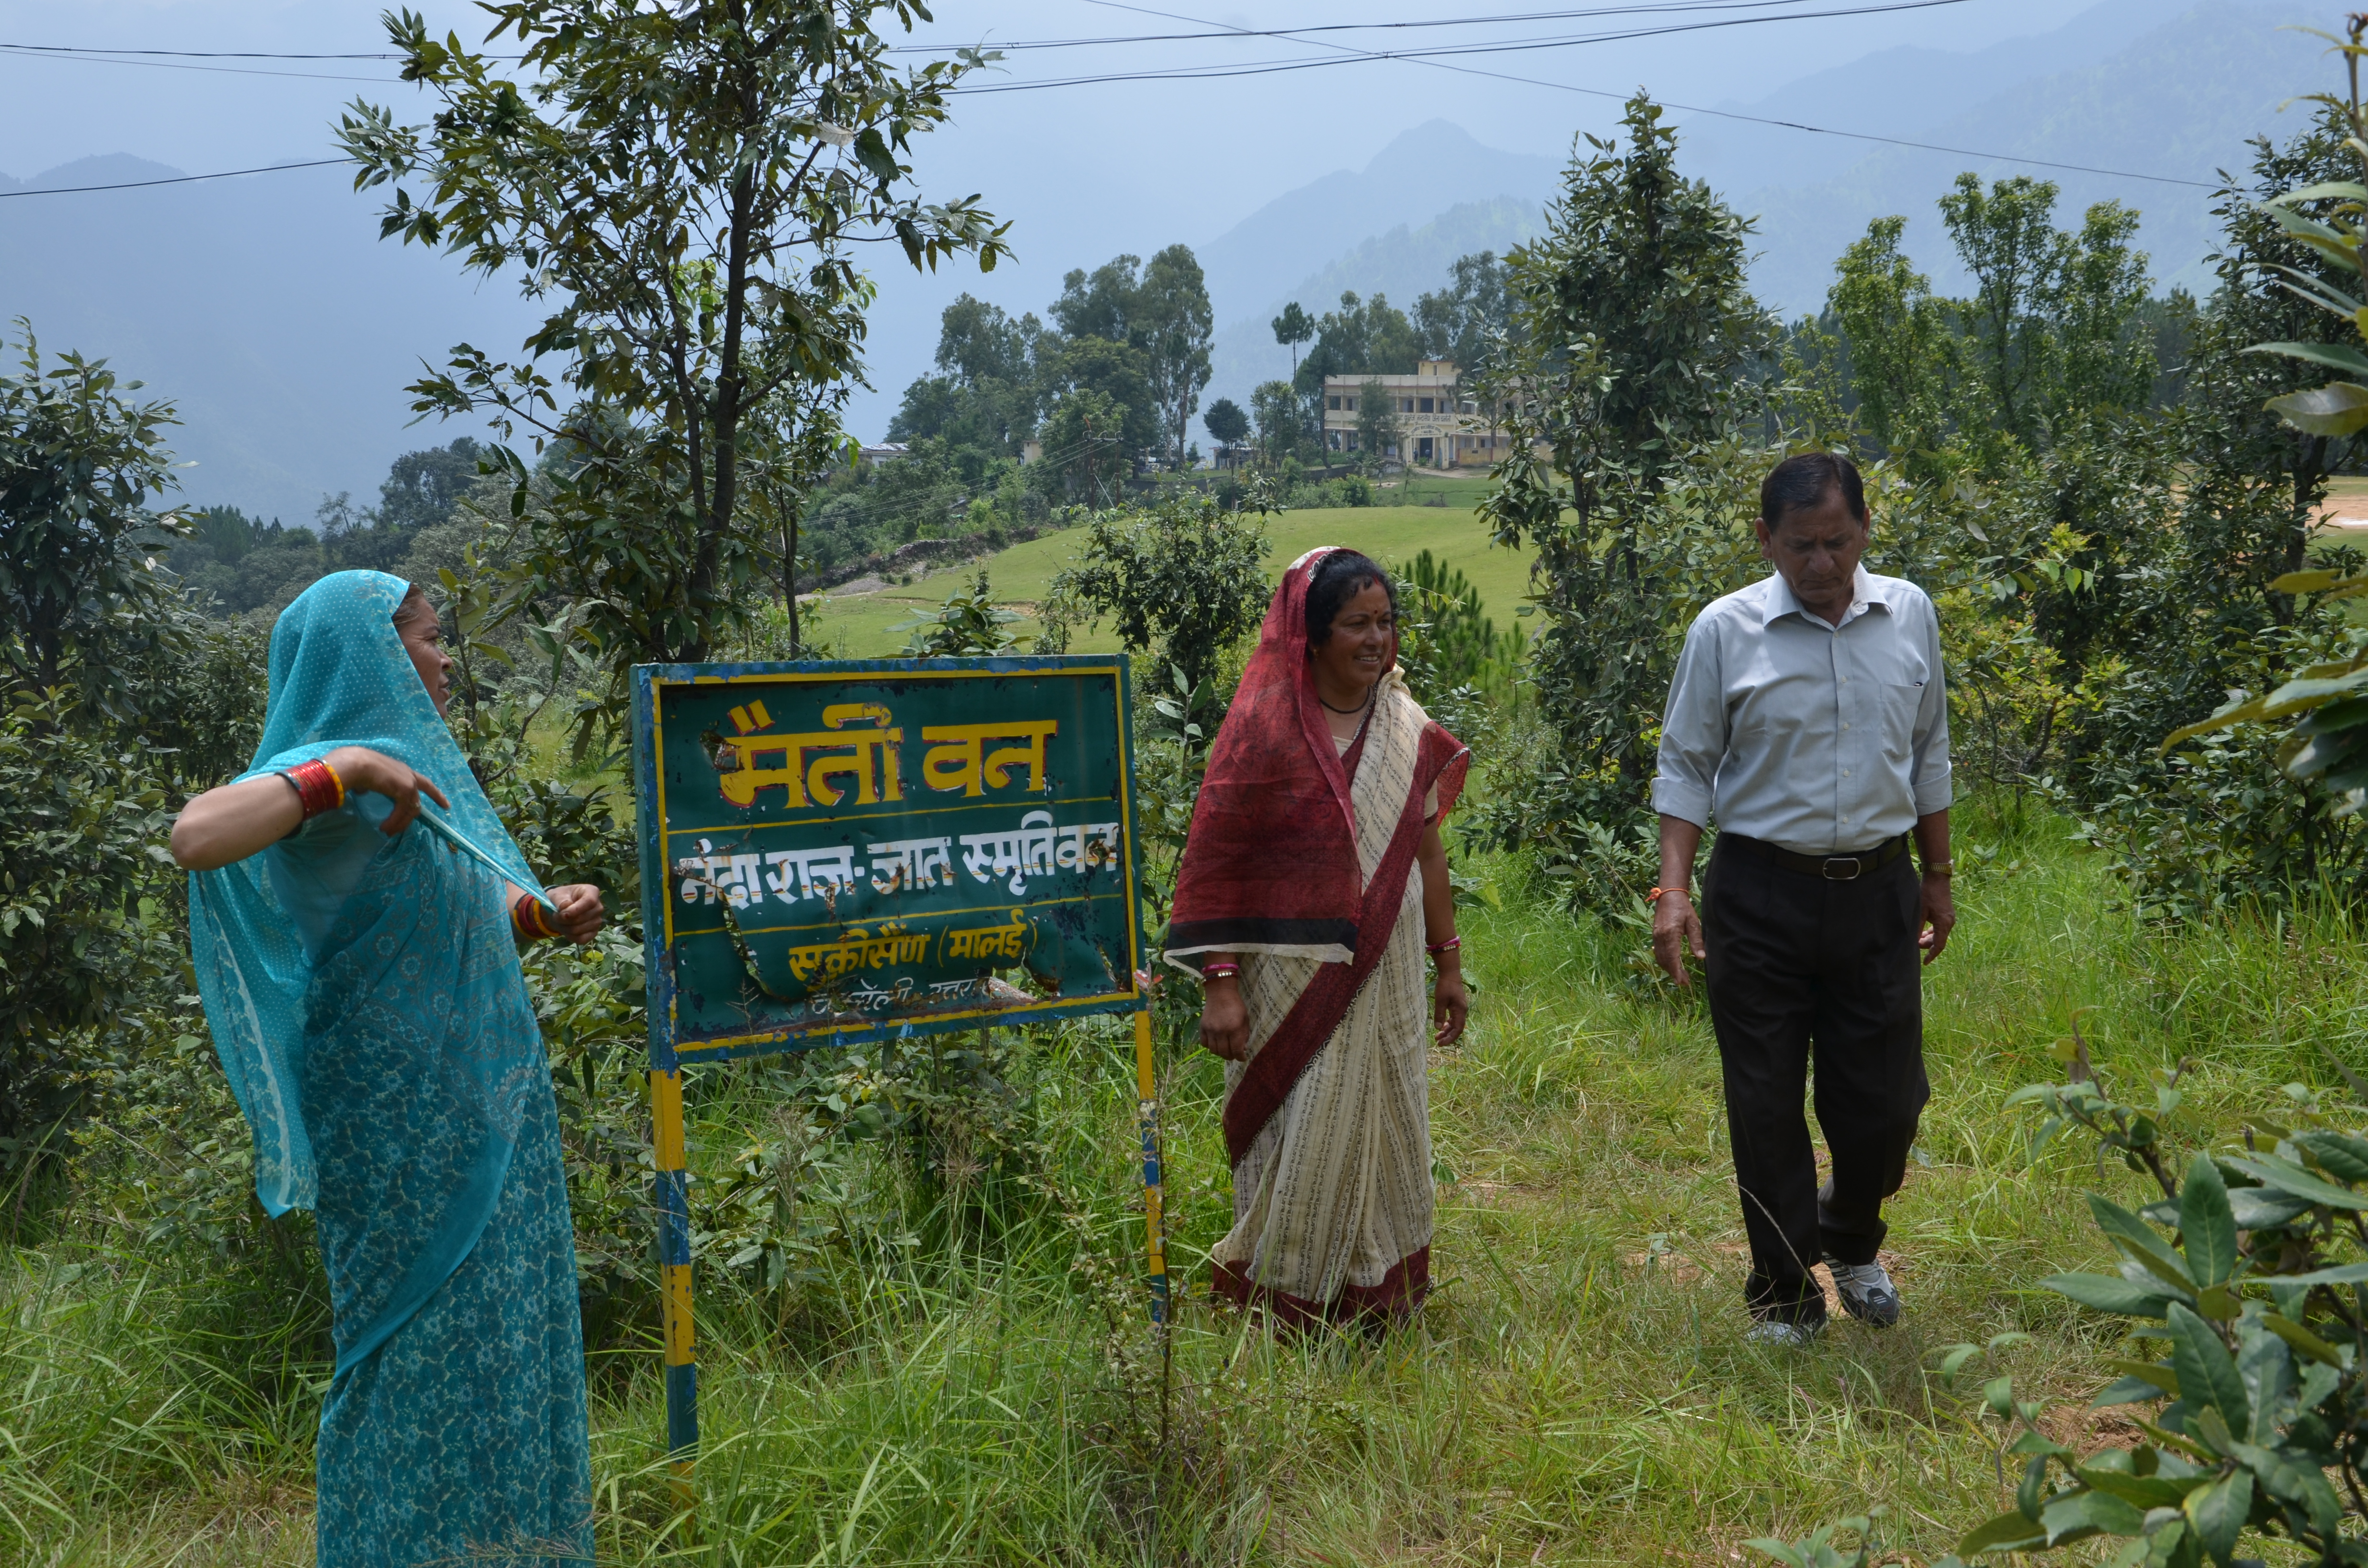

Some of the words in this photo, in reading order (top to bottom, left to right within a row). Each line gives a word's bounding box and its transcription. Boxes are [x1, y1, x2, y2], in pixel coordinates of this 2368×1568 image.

[719, 699, 905, 808] मैती
[922, 720, 1058, 797] वन
[678, 838, 763, 910] नंदा
